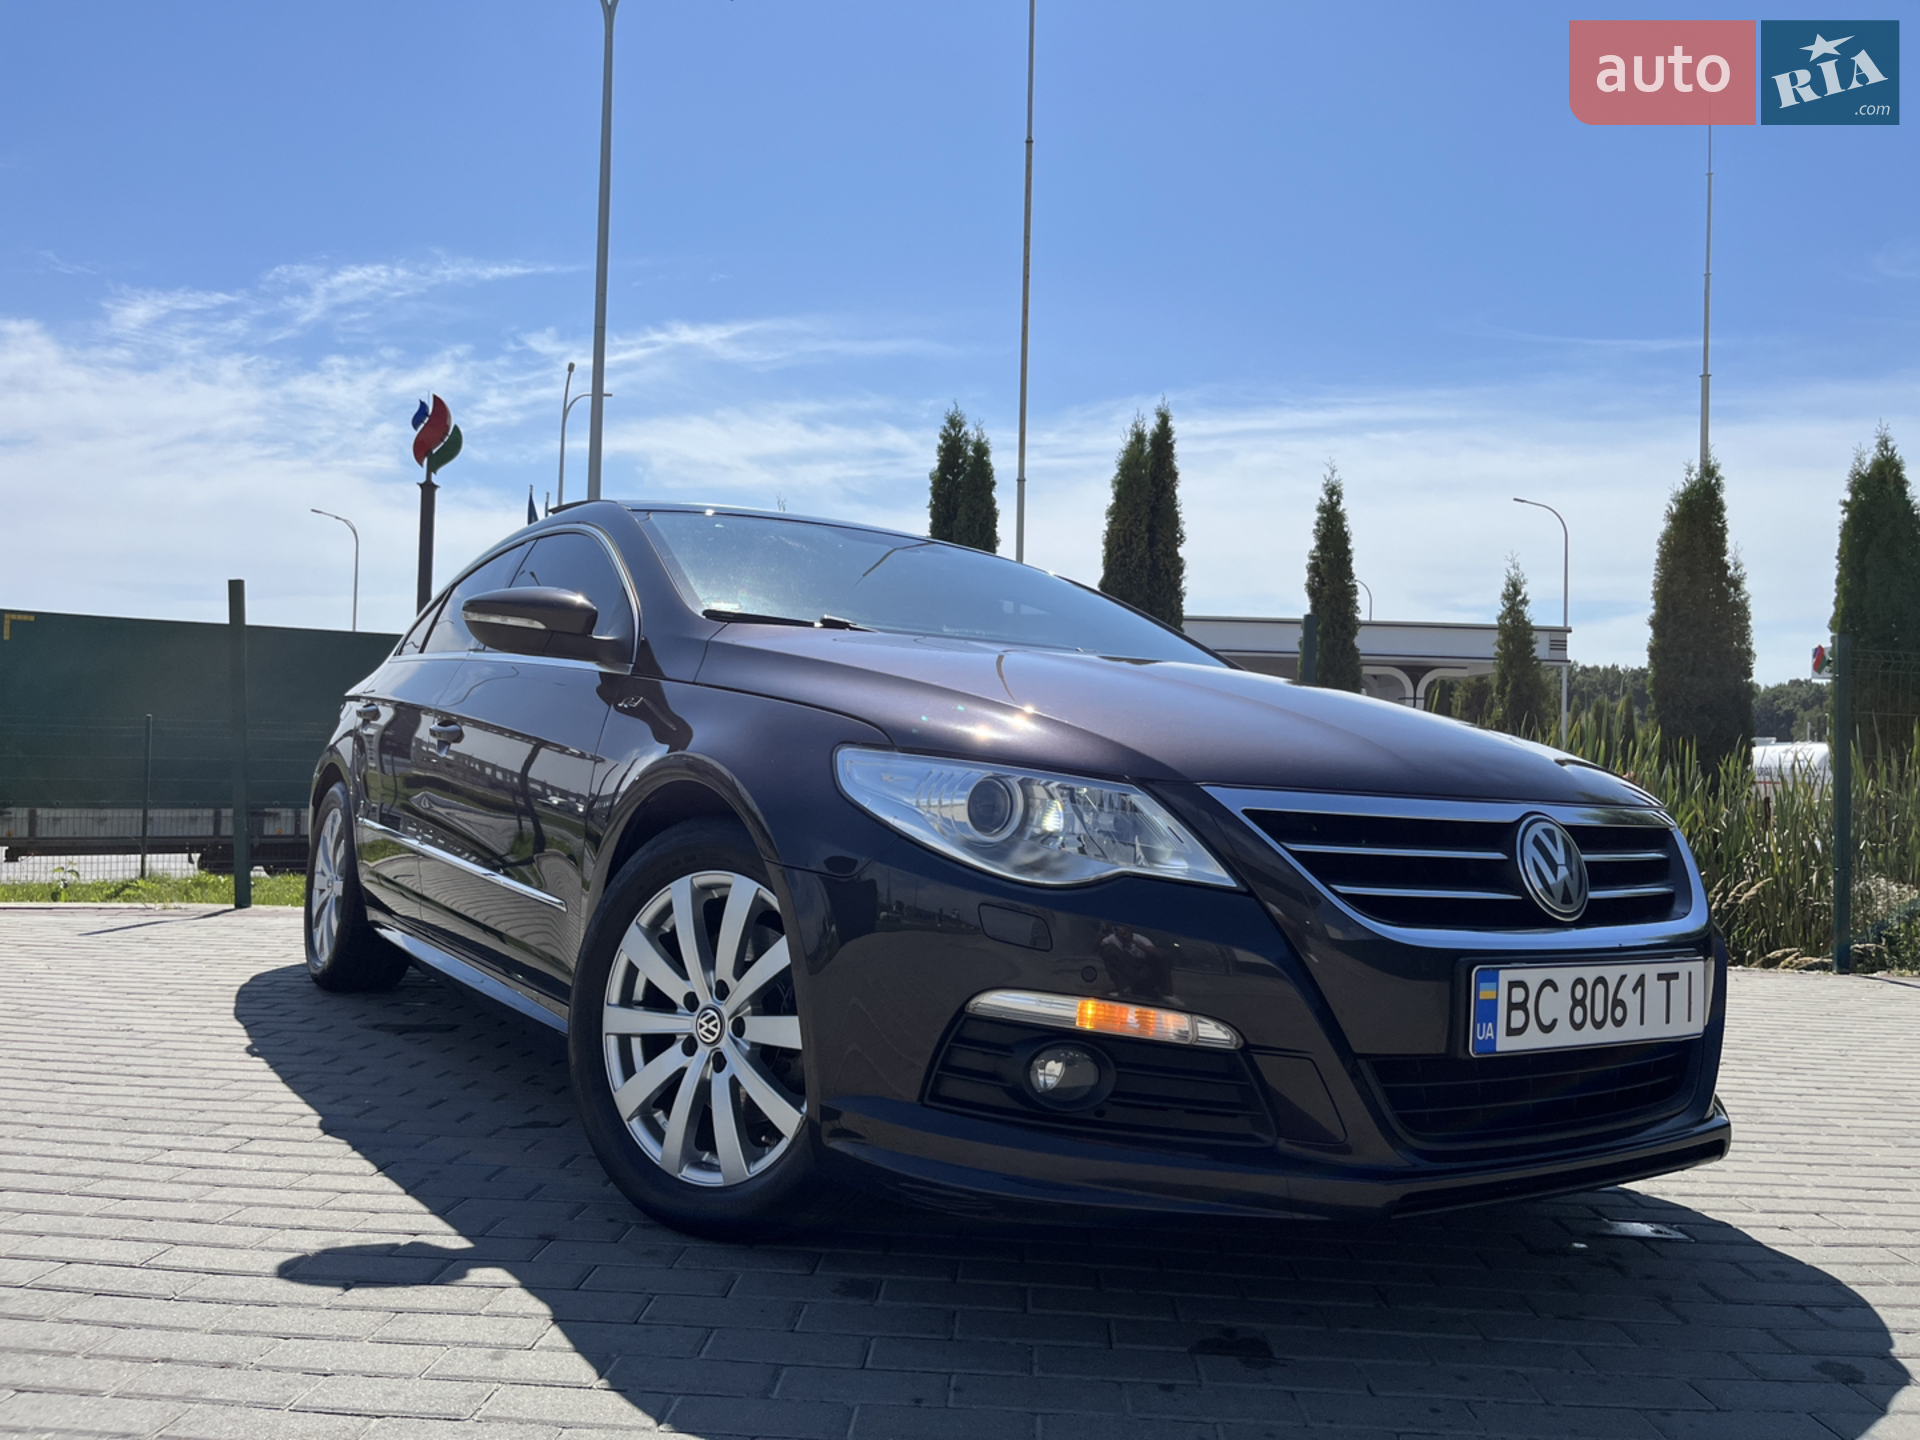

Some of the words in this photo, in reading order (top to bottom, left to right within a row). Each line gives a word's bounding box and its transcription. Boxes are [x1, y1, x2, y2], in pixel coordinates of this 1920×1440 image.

[1476, 1022, 1494, 1040] UA
[1505, 979, 1559, 1037] BC
[1569, 974, 1646, 1031] 8061
[1656, 970, 1692, 1025] TI
